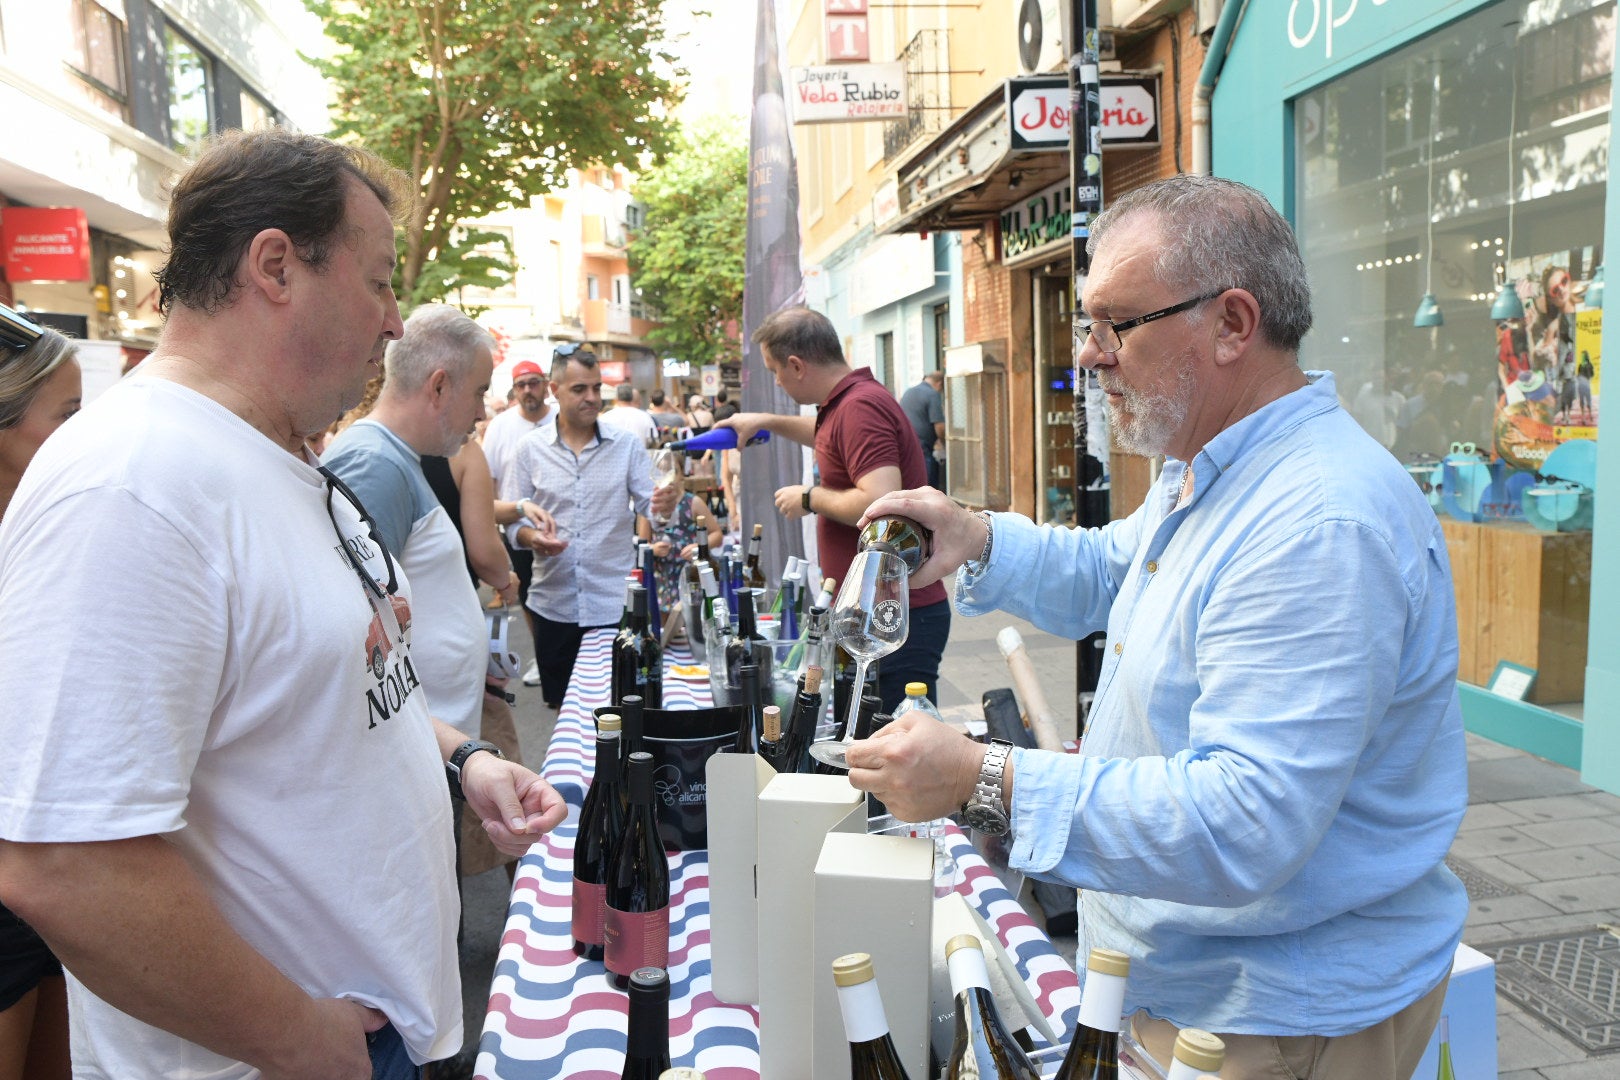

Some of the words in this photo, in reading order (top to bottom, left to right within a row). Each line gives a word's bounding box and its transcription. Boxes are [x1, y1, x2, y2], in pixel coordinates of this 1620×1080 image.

[798, 84, 839, 104] Vela
[842, 82, 900, 102] Rubio
[1020, 95, 1149, 131] Joria
